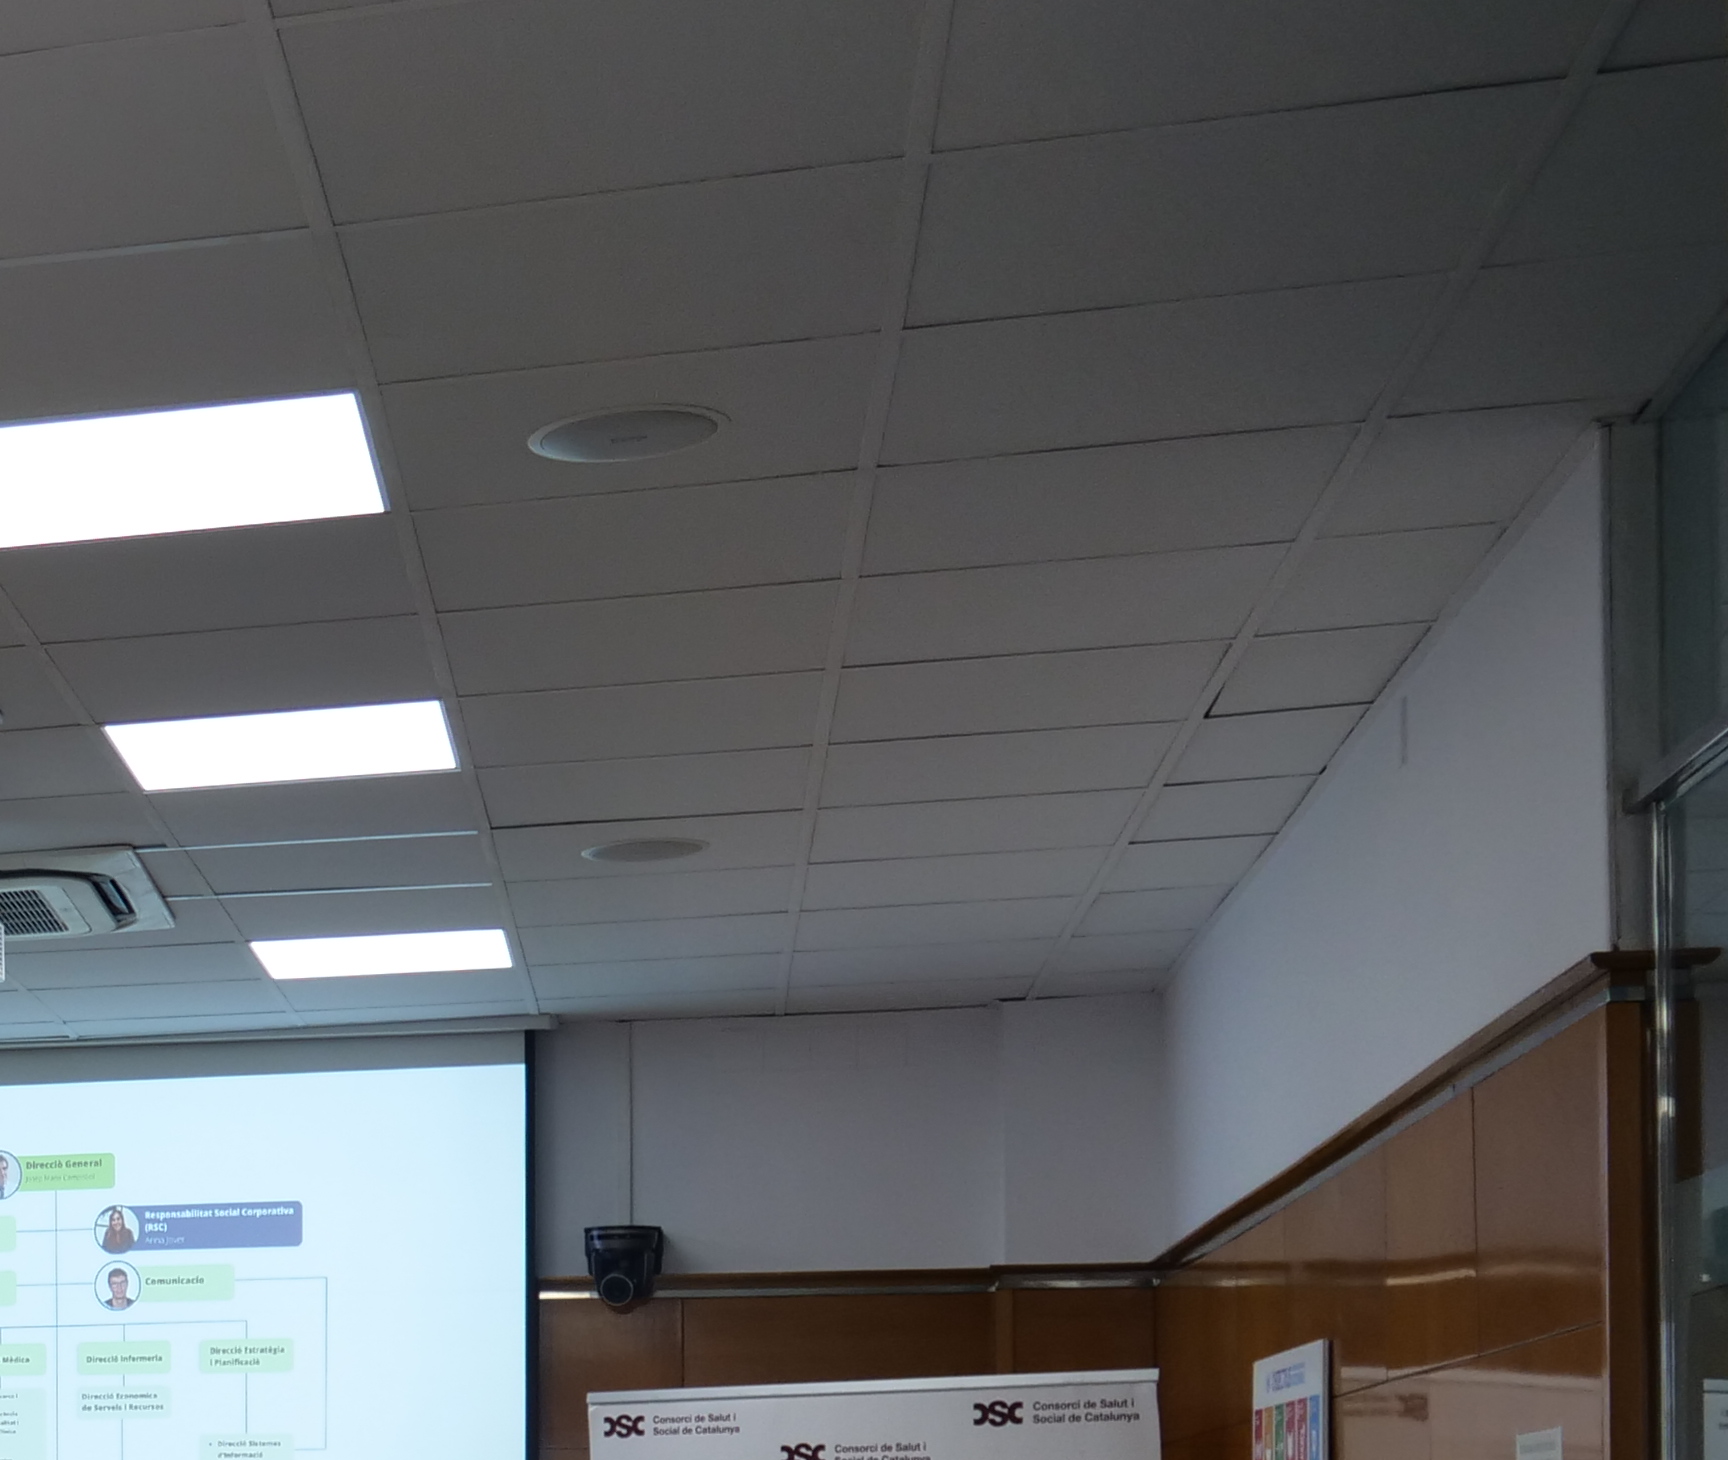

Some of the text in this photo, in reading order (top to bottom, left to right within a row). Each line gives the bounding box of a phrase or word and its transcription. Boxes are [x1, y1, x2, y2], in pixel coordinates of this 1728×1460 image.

[65, 1159, 102, 1169] General
[145, 1206, 294, 1221] Responsabilitat Social Corporativa
[145, 1223, 167, 1233] (RSC)
[146, 1236, 165, 1244] Anna
[129, 1403, 164, 1411] Recursos
[1033, 1401, 1081, 1411] Consorci
[1084, 1400, 1097, 1409] de
[1100, 1399, 1128, 1409] Salut
[653, 1415, 692, 1424] Consorci
[695, 1414, 705, 1423] de
[708, 1414, 731, 1422] Salut
[1033, 1412, 1140, 1424] Social de Catalunya
[653, 1426, 740, 1436] Social de Catalunya
[835, 1444, 878, 1453] Consorci
[881, 1444, 893, 1452] de
[896, 1443, 921, 1452] Salut
